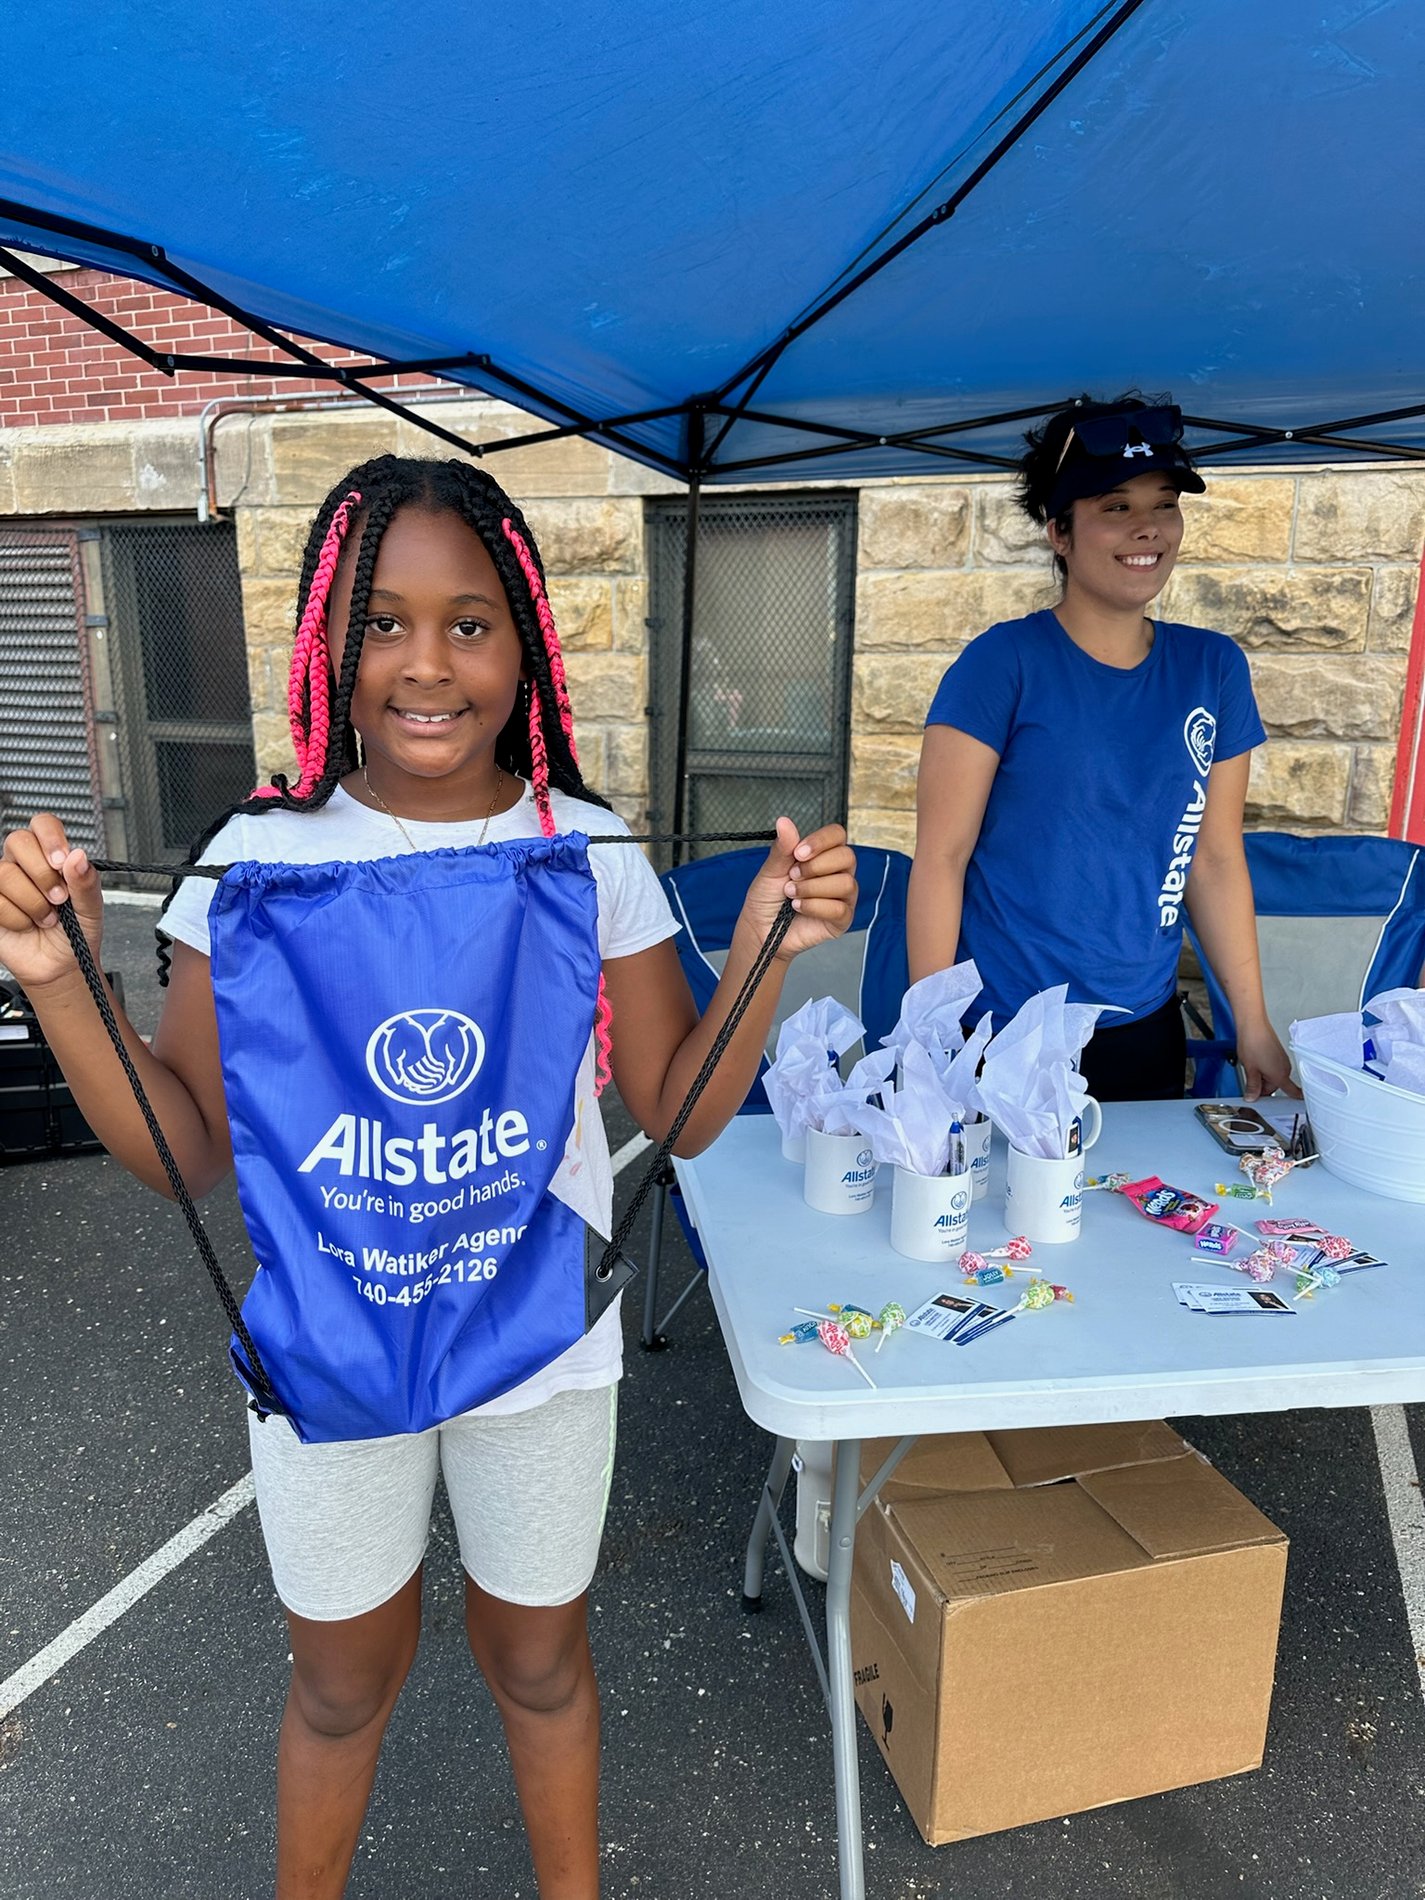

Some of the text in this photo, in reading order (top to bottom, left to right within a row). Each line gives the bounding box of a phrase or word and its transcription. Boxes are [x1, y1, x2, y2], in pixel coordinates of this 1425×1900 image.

[1157, 779, 1206, 927] Allstate
[297, 1107, 530, 1186] Allstate
[320, 1169, 526, 1224] You're in good hands.
[317, 1231, 356, 1268] Lora
[362, 1242, 450, 1276] Watiker
[352, 1256, 498, 1307] 740-455-2126
[853, 1663, 880, 1687] FRAGILE
